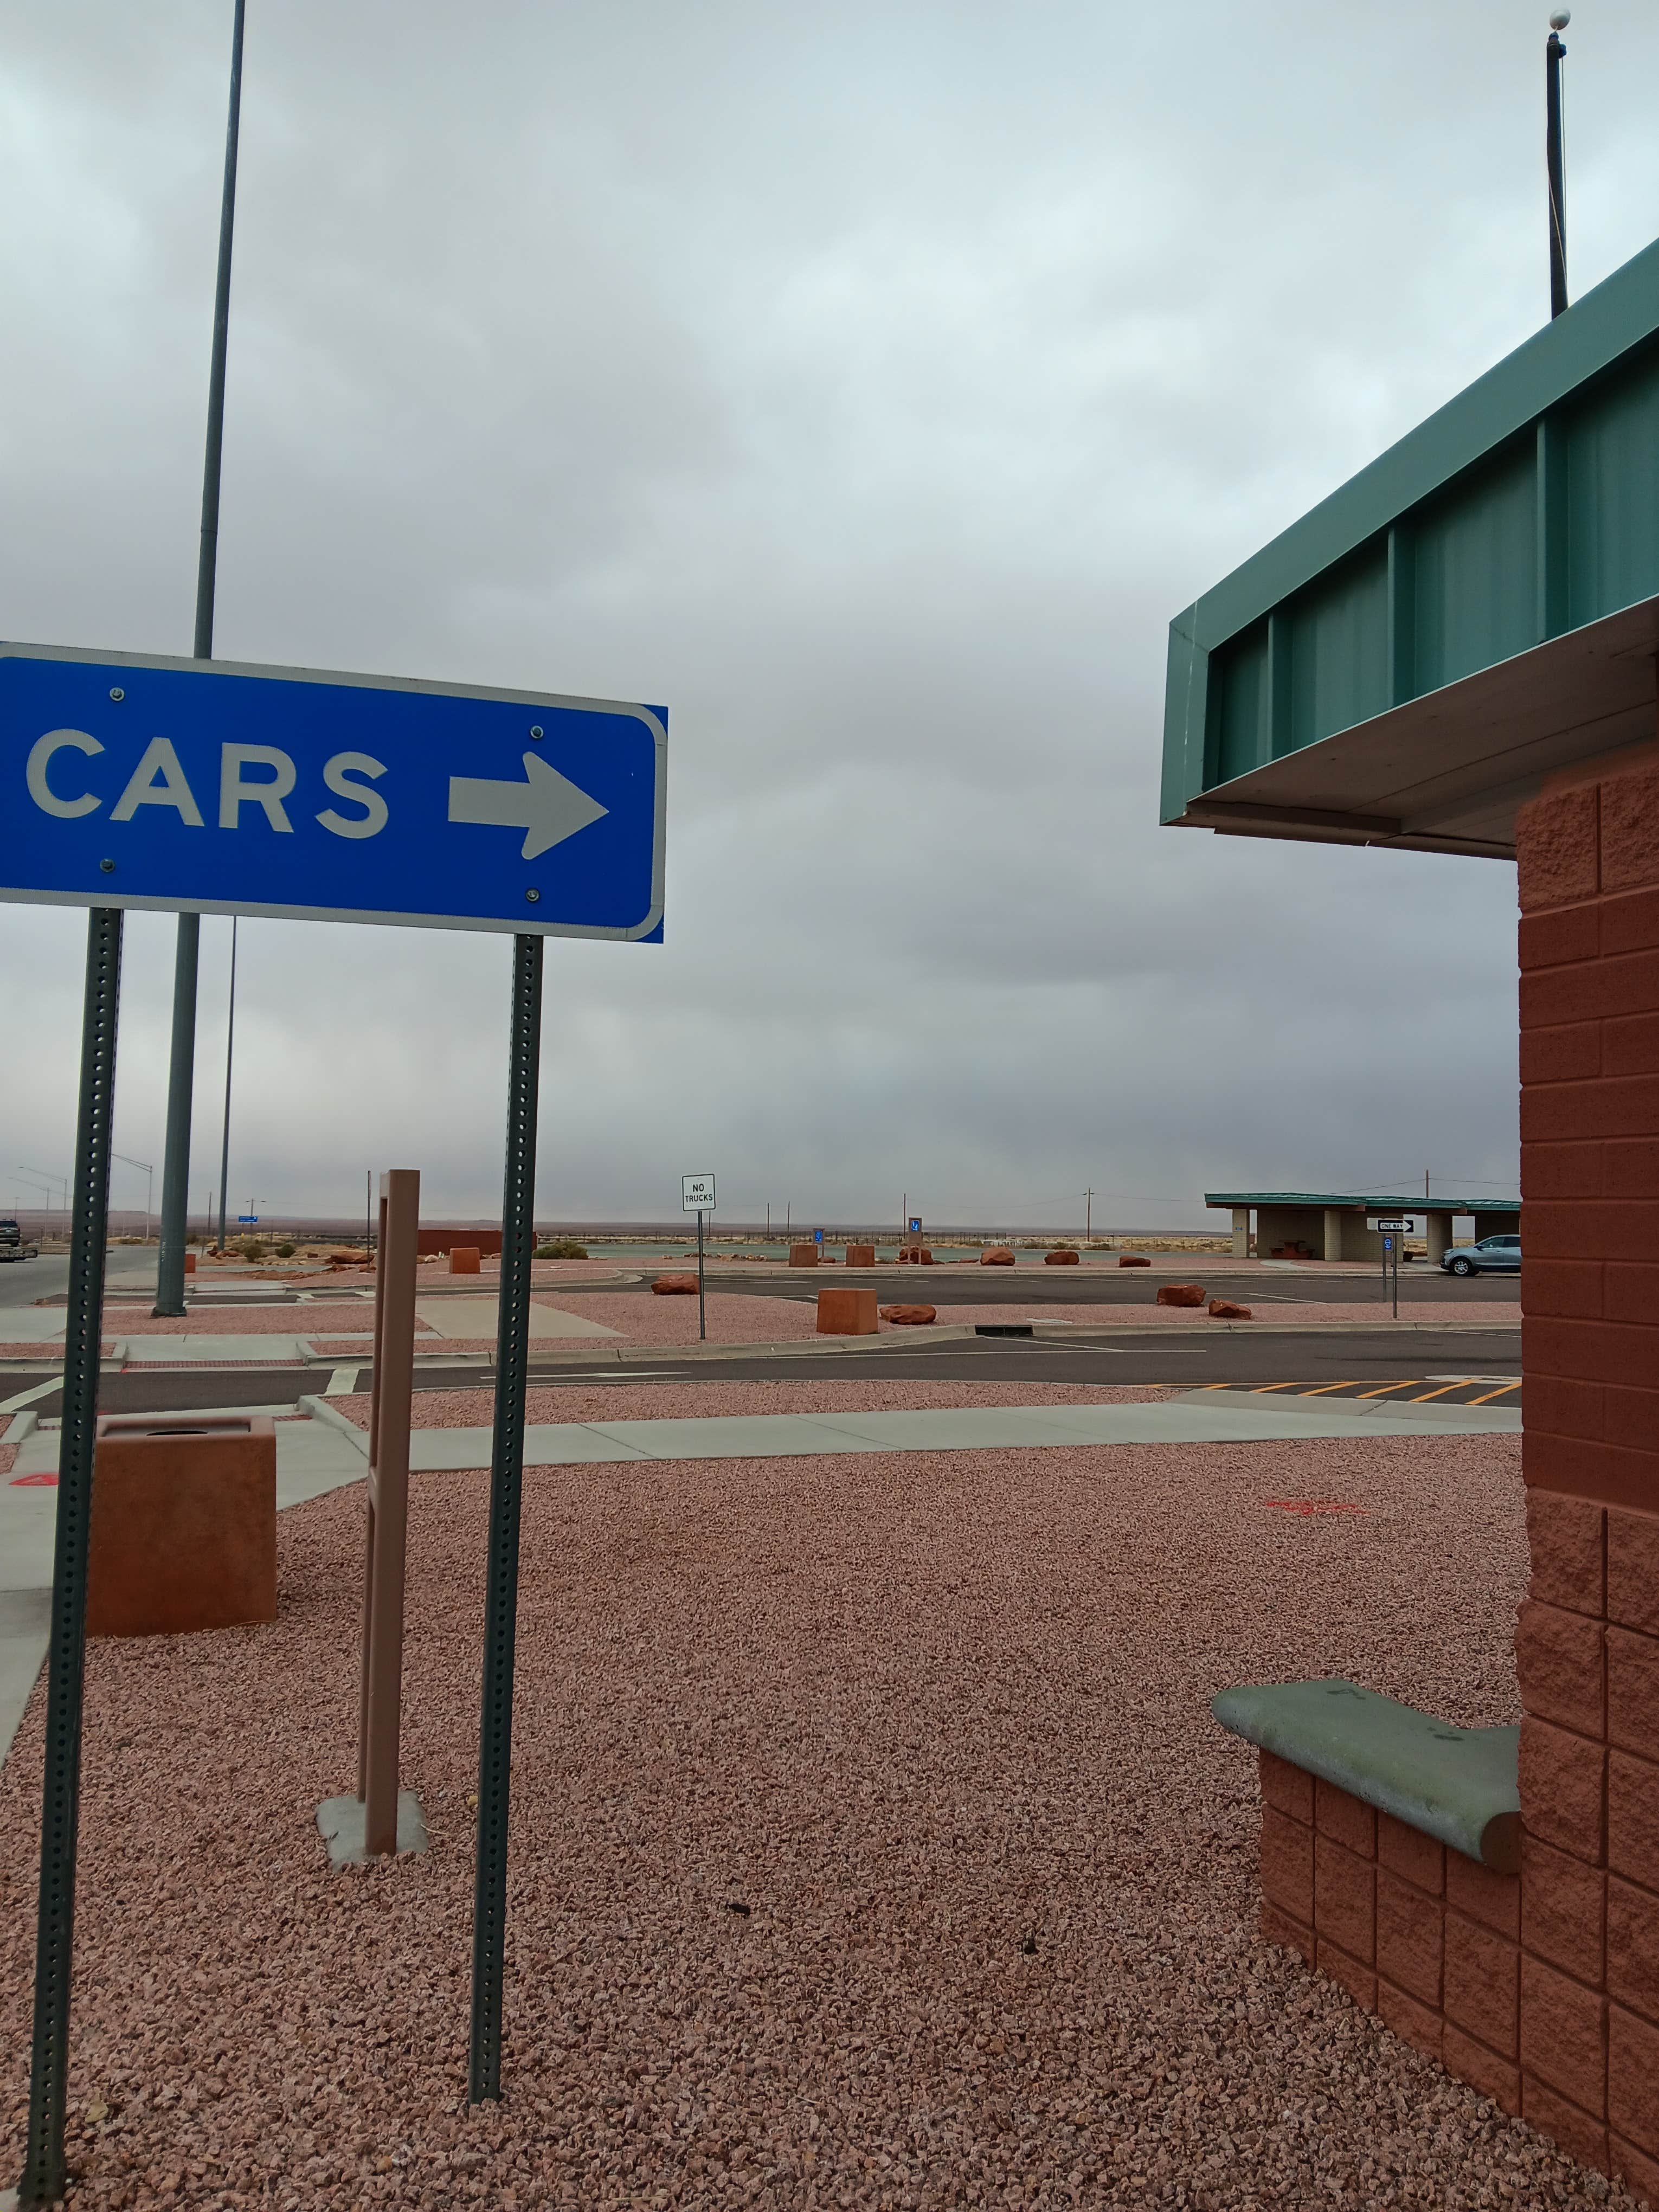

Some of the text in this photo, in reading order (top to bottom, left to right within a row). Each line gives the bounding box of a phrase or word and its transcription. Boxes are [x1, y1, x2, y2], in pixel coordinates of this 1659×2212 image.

[27, 729, 389, 839] CARS
[692, 1183, 704, 1192] NO
[685, 1193, 713, 1203] TRUCKS
